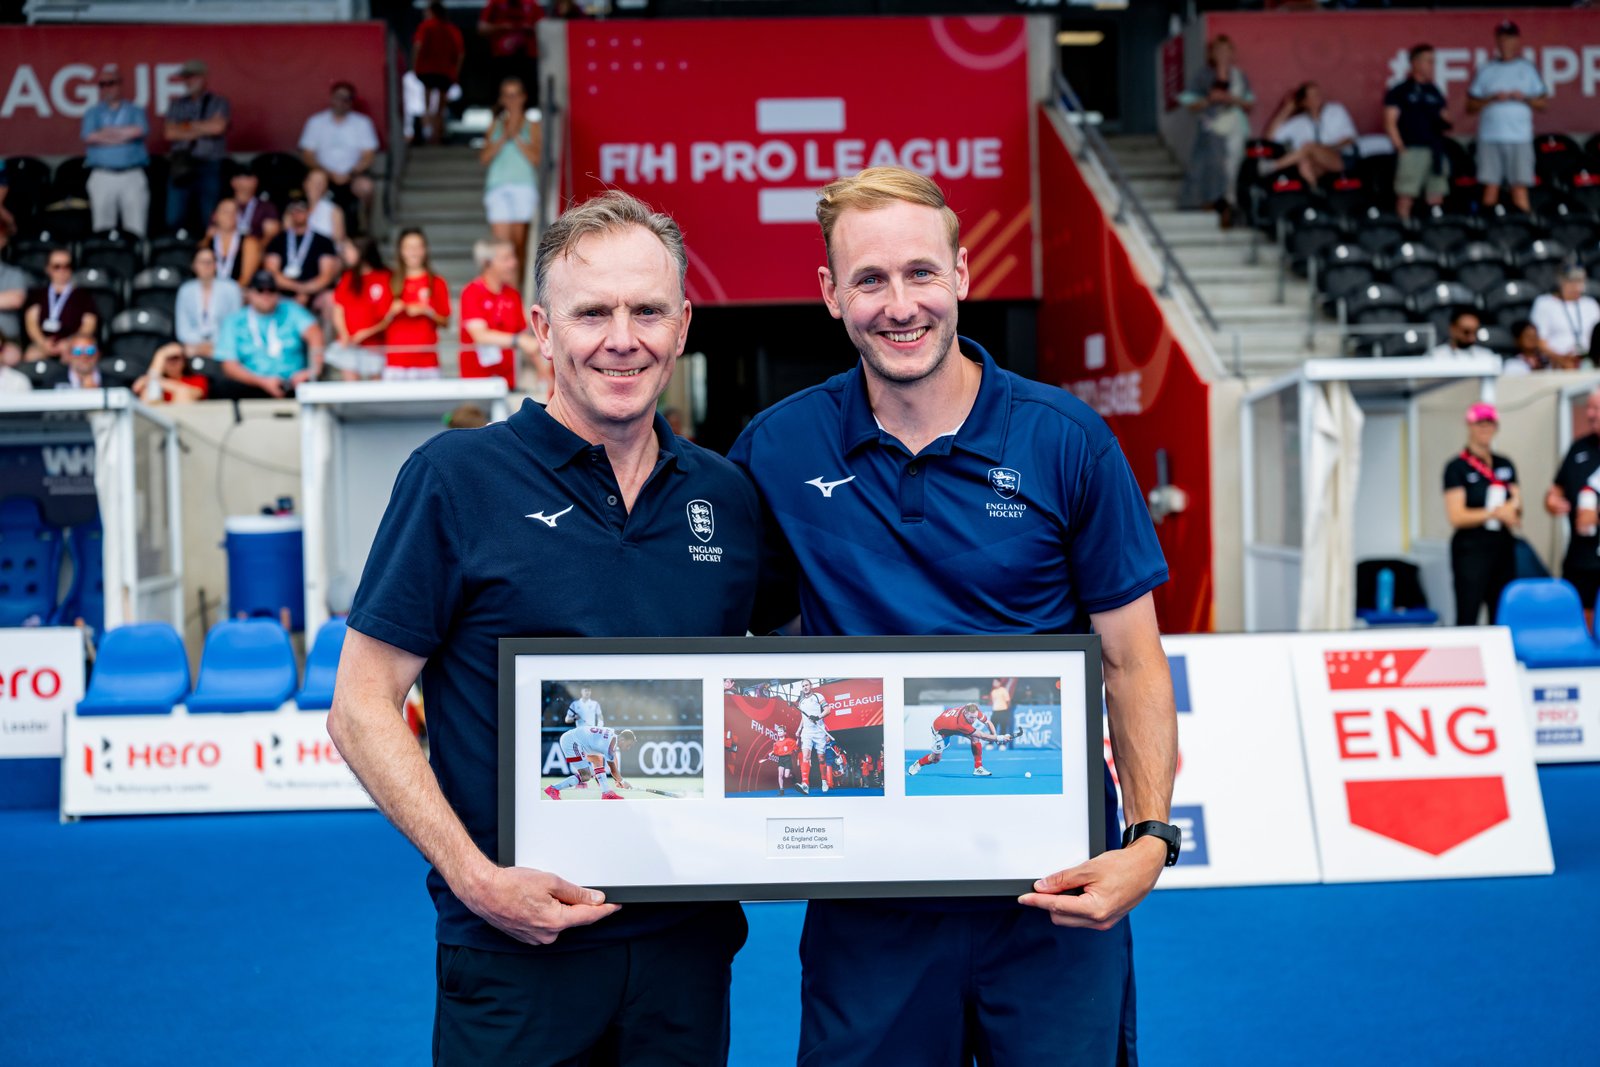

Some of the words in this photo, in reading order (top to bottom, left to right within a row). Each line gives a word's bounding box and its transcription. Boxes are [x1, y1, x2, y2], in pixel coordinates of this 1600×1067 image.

[690, 140, 797, 182] PRO
[804, 137, 1003, 180] LEAGUE
[989, 510, 1023, 518] HOCKEY
[688, 545, 723, 554] ENGLAND
[692, 554, 721, 562] HOCKEY
[0, 667, 61, 700] ro
[843, 695, 883, 708] LEAGUE
[1333, 706, 1498, 760] ENG
[127, 742, 221, 768] Hero
